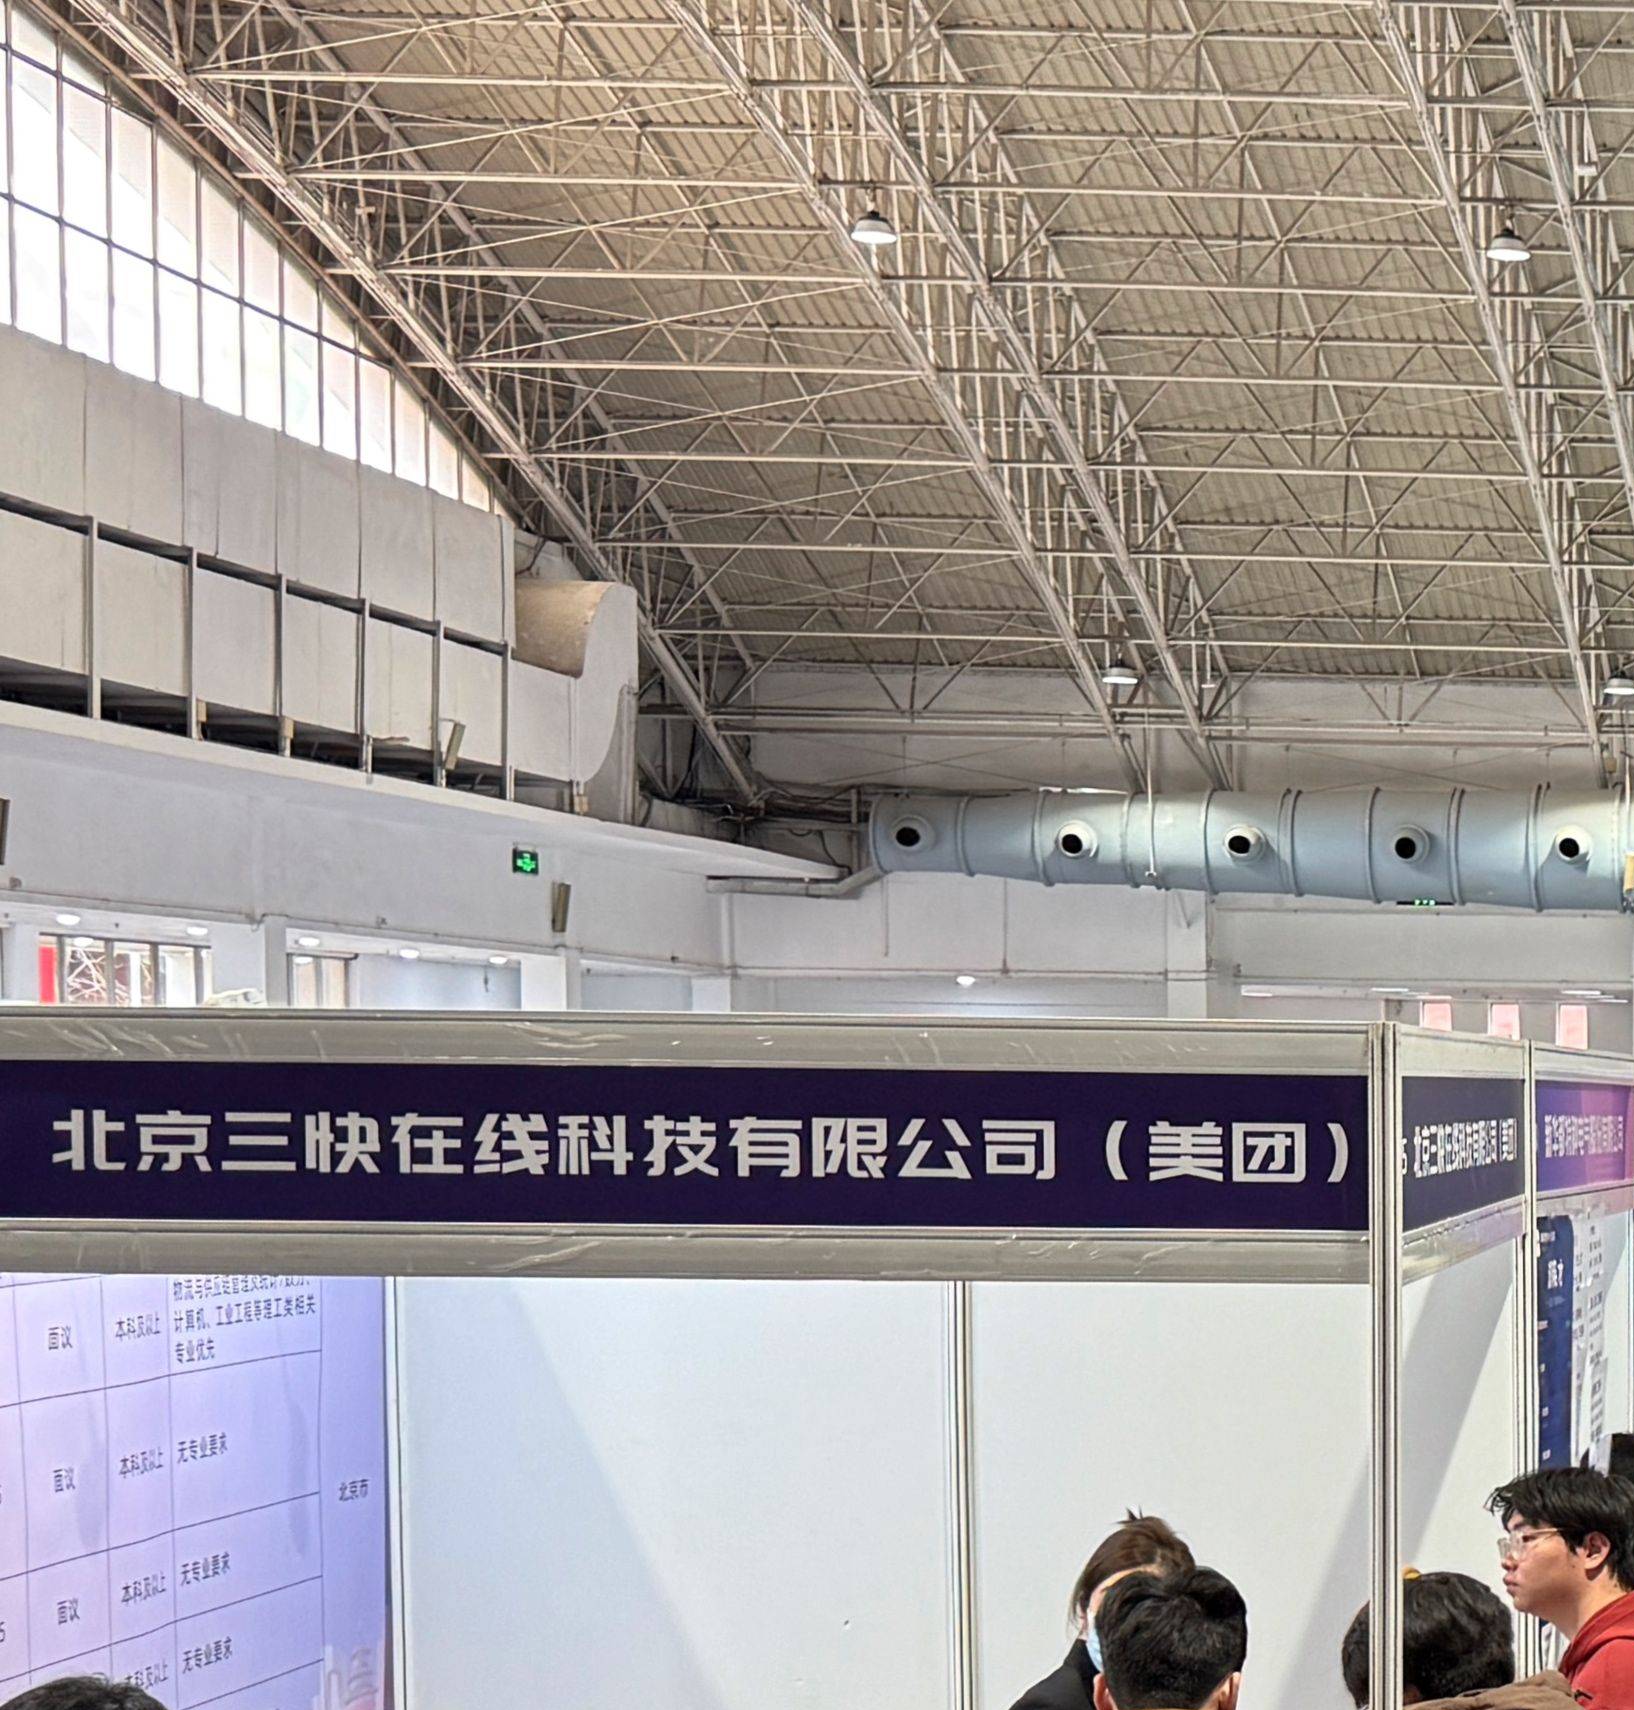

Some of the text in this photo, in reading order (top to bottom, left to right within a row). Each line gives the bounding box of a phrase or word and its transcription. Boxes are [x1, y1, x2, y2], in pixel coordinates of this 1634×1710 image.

[52, 1108, 1350, 1184] 北京三快在线科技有限公司（美团）
[48, 1326, 73, 1351] 面议
[115, 1313, 161, 1342] 本科及以上
[175, 1336, 216, 1364] 专业优先
[177, 1431, 228, 1464] 无专业要求
[119, 1448, 164, 1479] 本科及以上
[53, 1467, 76, 1494] 面议
[338, 1478, 369, 1502] 北京市
[180, 1551, 231, 1588] 无专业要求
[121, 1570, 168, 1607] 本科及以上
[57, 1597, 80, 1626] 面议
[182, 1637, 233, 1675] 无专业要求
